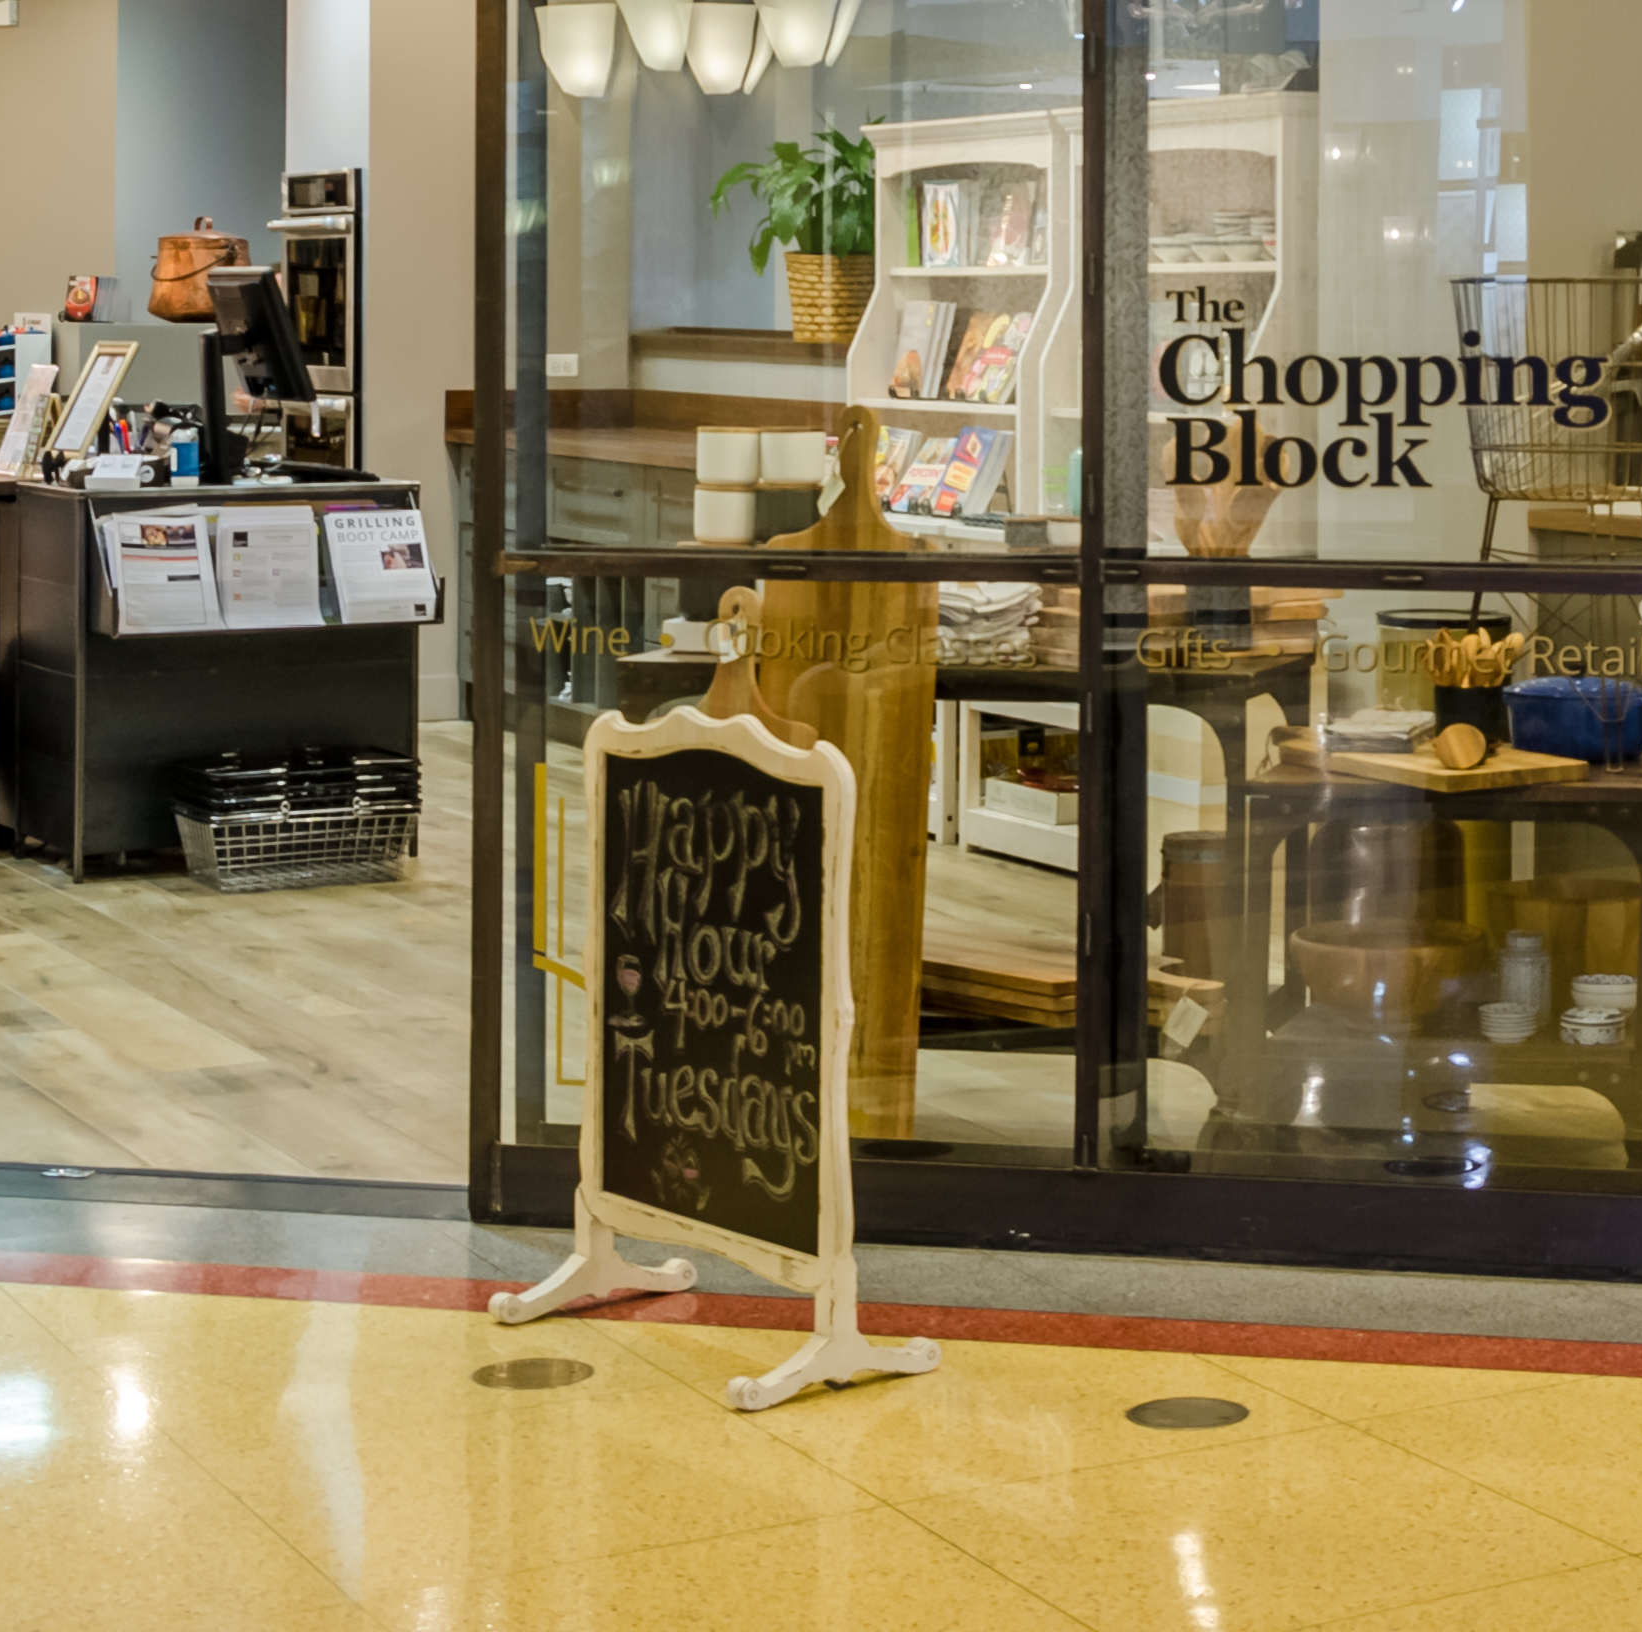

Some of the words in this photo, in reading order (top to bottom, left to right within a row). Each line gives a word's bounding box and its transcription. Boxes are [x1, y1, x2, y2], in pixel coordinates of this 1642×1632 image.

[1165, 285, 1245, 323] The
[1158, 329, 1611, 428] Chopping
[1165, 410, 1433, 487] Block
[334, 515, 416, 529] GRILLING
[337, 531, 375, 542] BOOT
[381, 529, 419, 541] CAMP
[529, 616, 631, 657] Wine
[704, 617, 872, 674] Cooking
[886, 622, 1039, 669] Classes
[1136, 628, 1232, 670] Gifts
[1315, 634, 1515, 675] Gourmet
[610, 779, 803, 951] Happy
[655, 867, 775, 993] Hour
[613, 1028, 819, 1202] Tuesdays
